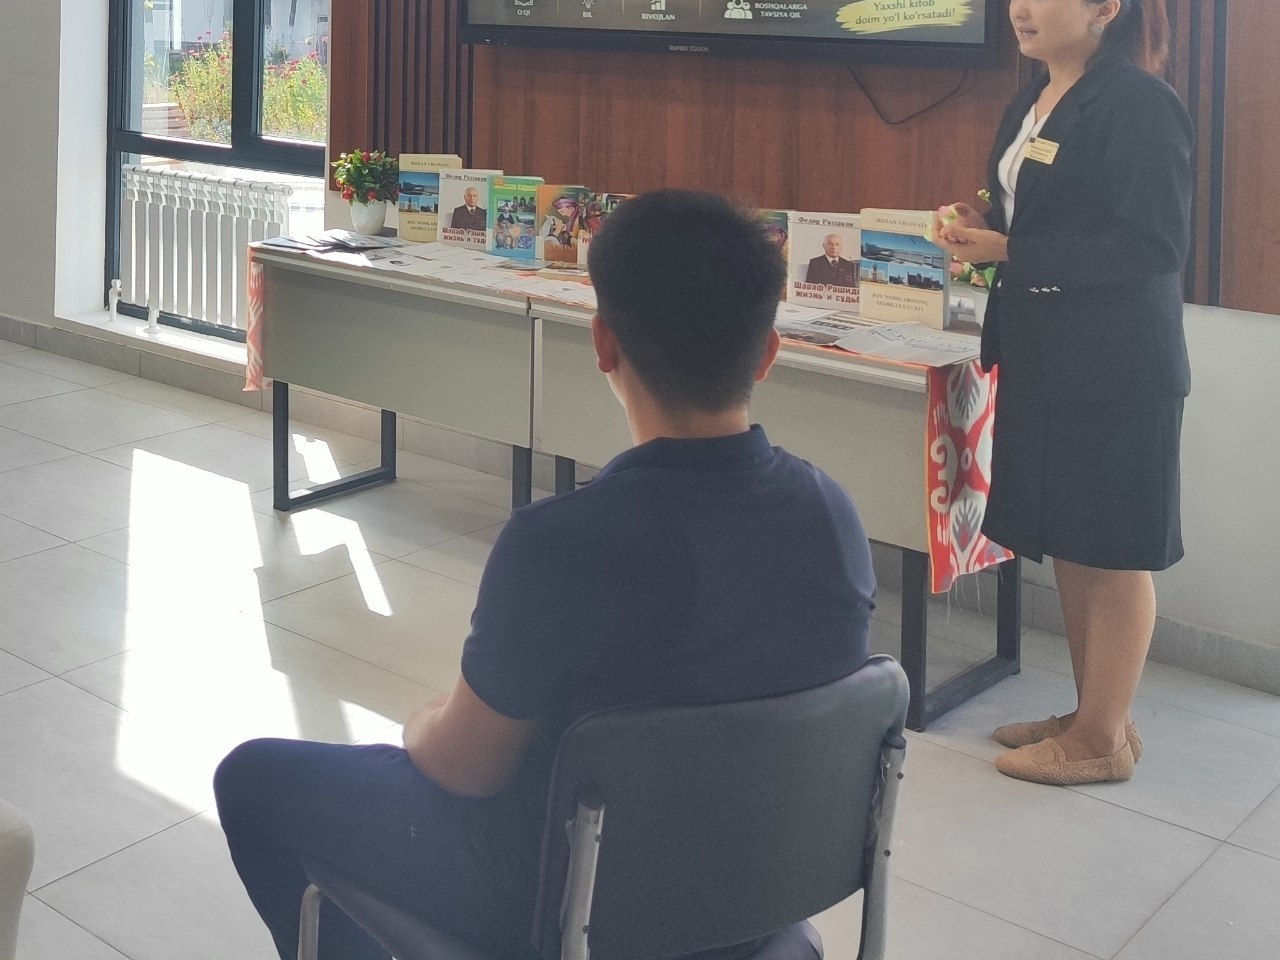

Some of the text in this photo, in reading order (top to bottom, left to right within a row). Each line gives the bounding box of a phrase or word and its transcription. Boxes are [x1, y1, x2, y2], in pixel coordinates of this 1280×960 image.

[755, 2, 807, 10] BOSHQALARGA
[874, 1, 905, 11] Yaxshi
[642, 13, 675, 21] RIVOJLAN
[856, 16, 880, 25] doim
[794, 281, 823, 291] Шараф
[796, 291, 823, 299] жизнь
